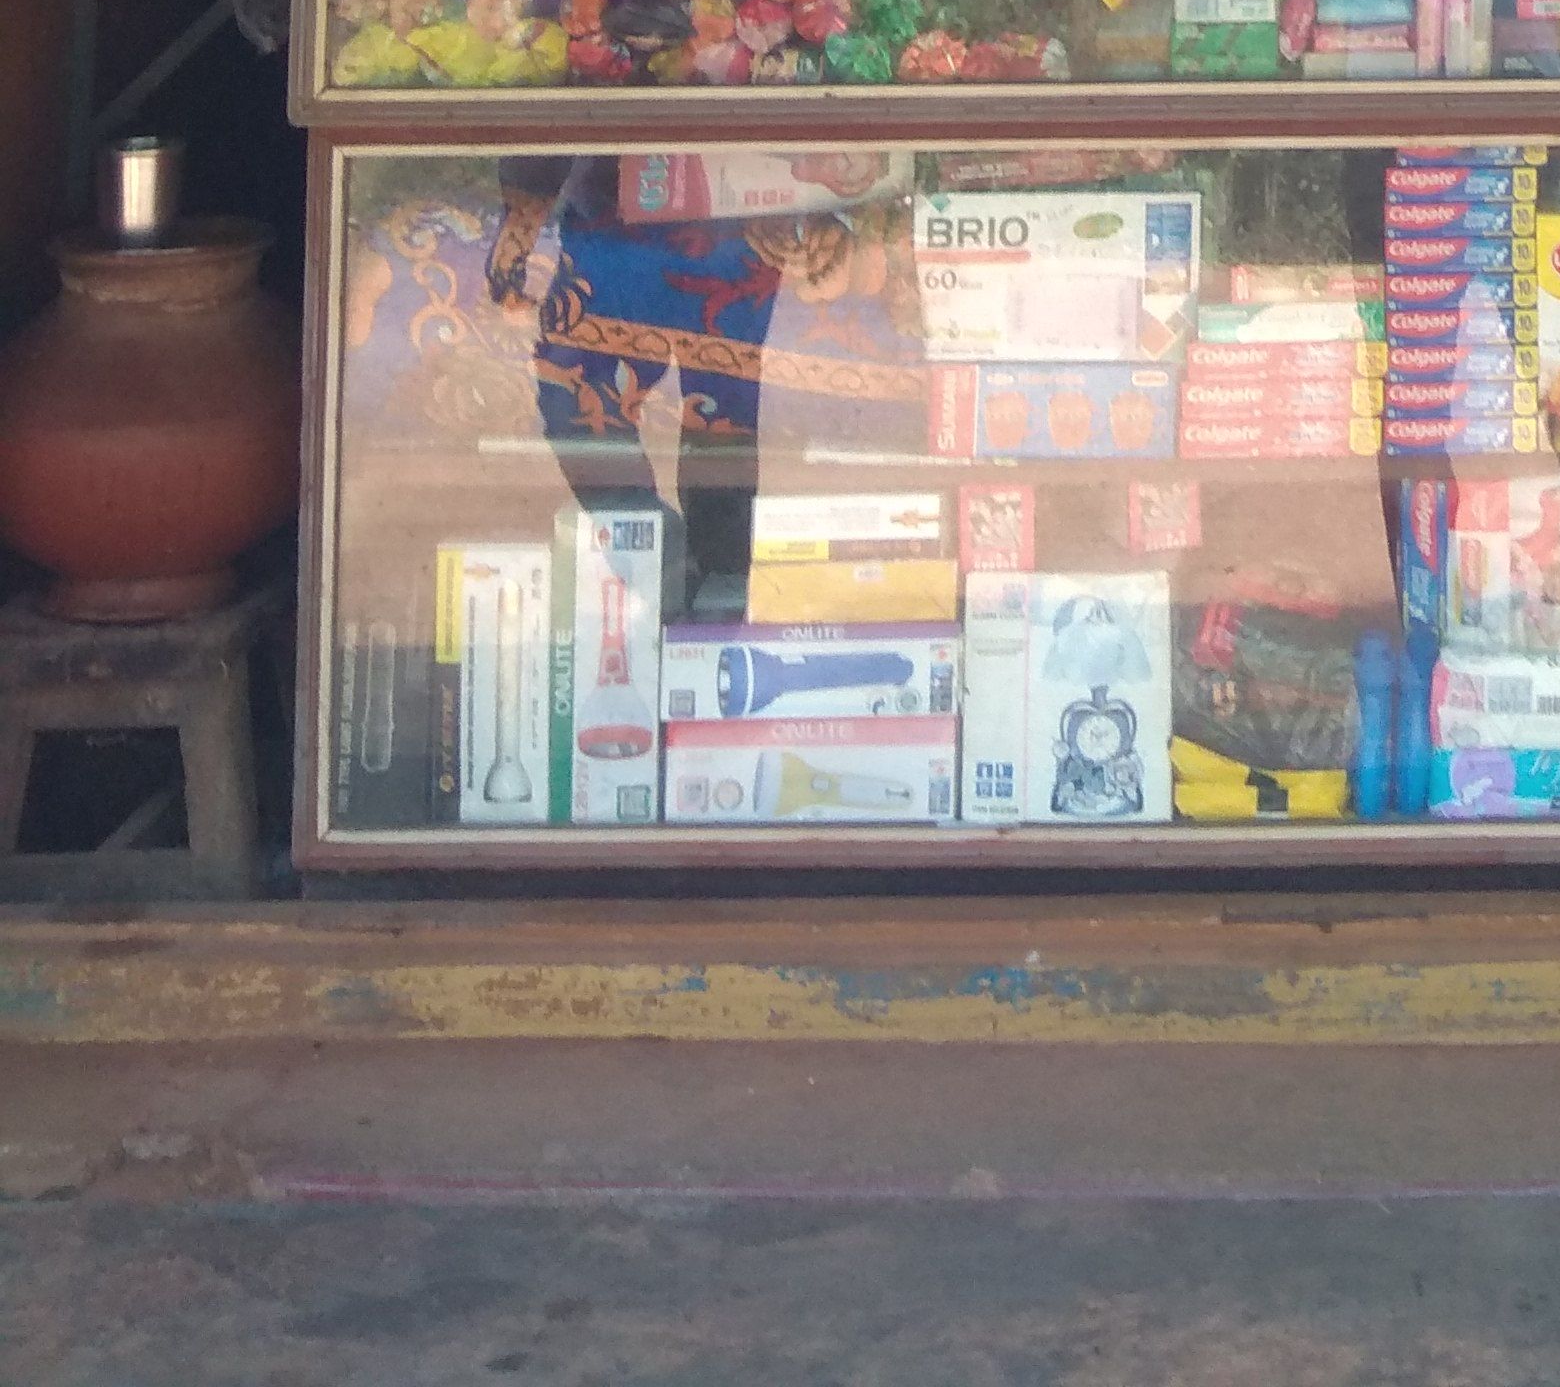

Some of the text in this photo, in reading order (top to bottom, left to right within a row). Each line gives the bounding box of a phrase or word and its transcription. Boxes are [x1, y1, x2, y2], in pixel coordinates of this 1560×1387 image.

[1391, 171, 1456, 187] Colgate
[1389, 206, 1454, 223] Colgate
[926, 215, 1030, 248] BRIO
[1389, 241, 1456, 258] Colgate
[924, 269, 957, 291] 60
[1389, 277, 1456, 294] Colgate
[1391, 313, 1458, 330] Colgate
[1191, 348, 1270, 366] Colgate
[1390, 350, 1457, 367] Colgate
[1186, 385, 1264, 404] Colgate
[1389, 385, 1455, 403] Colgate
[1184, 425, 1262, 444] Colgate
[1388, 421, 1455, 440] Colgate
